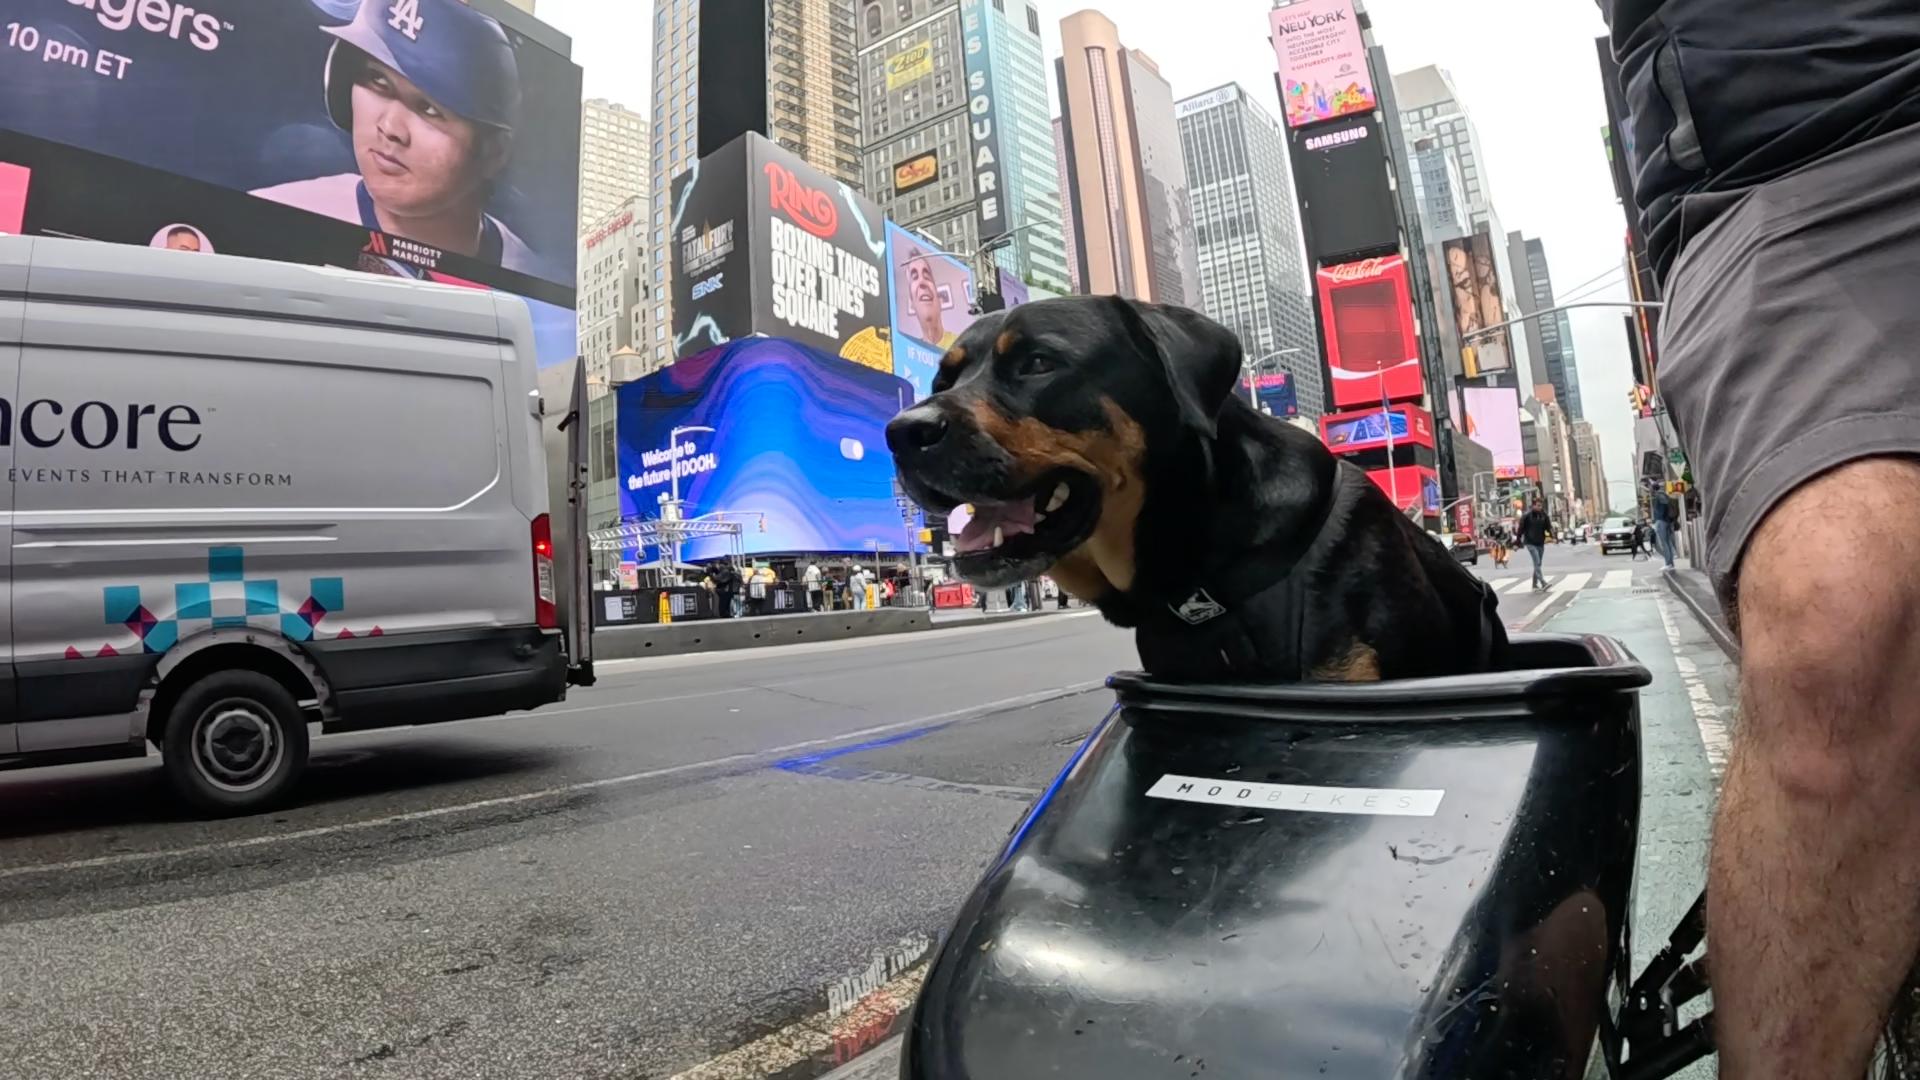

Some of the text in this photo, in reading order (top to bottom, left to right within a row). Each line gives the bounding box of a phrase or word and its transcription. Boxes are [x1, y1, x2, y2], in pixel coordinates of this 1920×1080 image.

[1307, 8, 1347, 28] YORK
[1303, 31, 1315, 39] THE
[1326, 38, 1341, 46] CITY
[6, 22, 133, 80] 10 pm ET
[1289, 50, 1323, 62] TOGETHER
[1181, 96, 1215, 114] Allianz
[969, 70, 998, 221] SQUARE
[1305, 126, 1368, 150] SAMSUNG
[764, 162, 838, 238] RING
[392, 238, 442, 259] MARRIOTT
[392, 249, 436, 268] MARQUIS
[770, 216, 835, 275] BOXING
[835, 246, 880, 297] TAKES
[692, 272, 723, 300] SNK
[771, 250, 818, 297] OVER
[818, 269, 864, 319] TIMES
[772, 283, 839, 339] SQUARE
[684, 440, 697, 456] to
[8, 468, 292, 486] EVENTS THAT TRANSFORM
[628, 474, 644, 490] the
[643, 468, 671, 487] future
